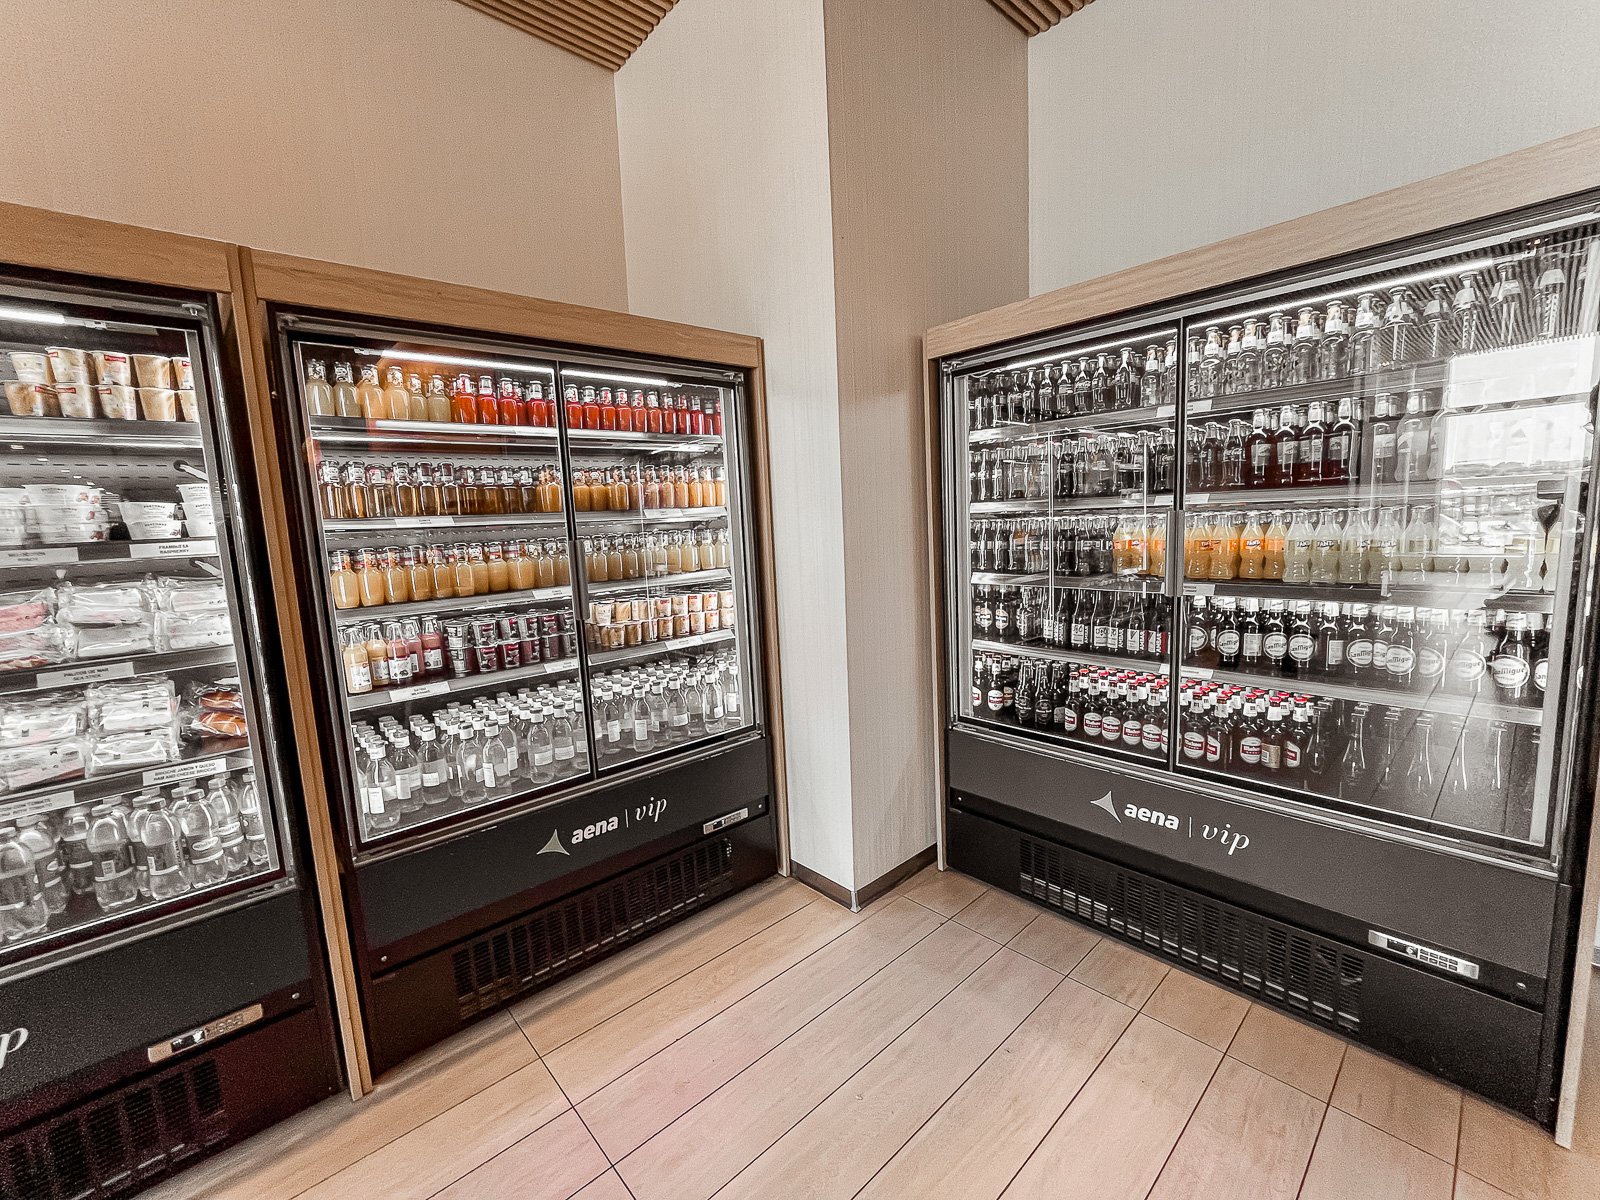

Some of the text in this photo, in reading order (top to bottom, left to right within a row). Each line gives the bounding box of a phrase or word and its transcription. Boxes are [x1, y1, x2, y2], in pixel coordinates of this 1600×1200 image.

[571, 796, 667, 844] aena vip
[1124, 803, 1250, 856] aena vip
